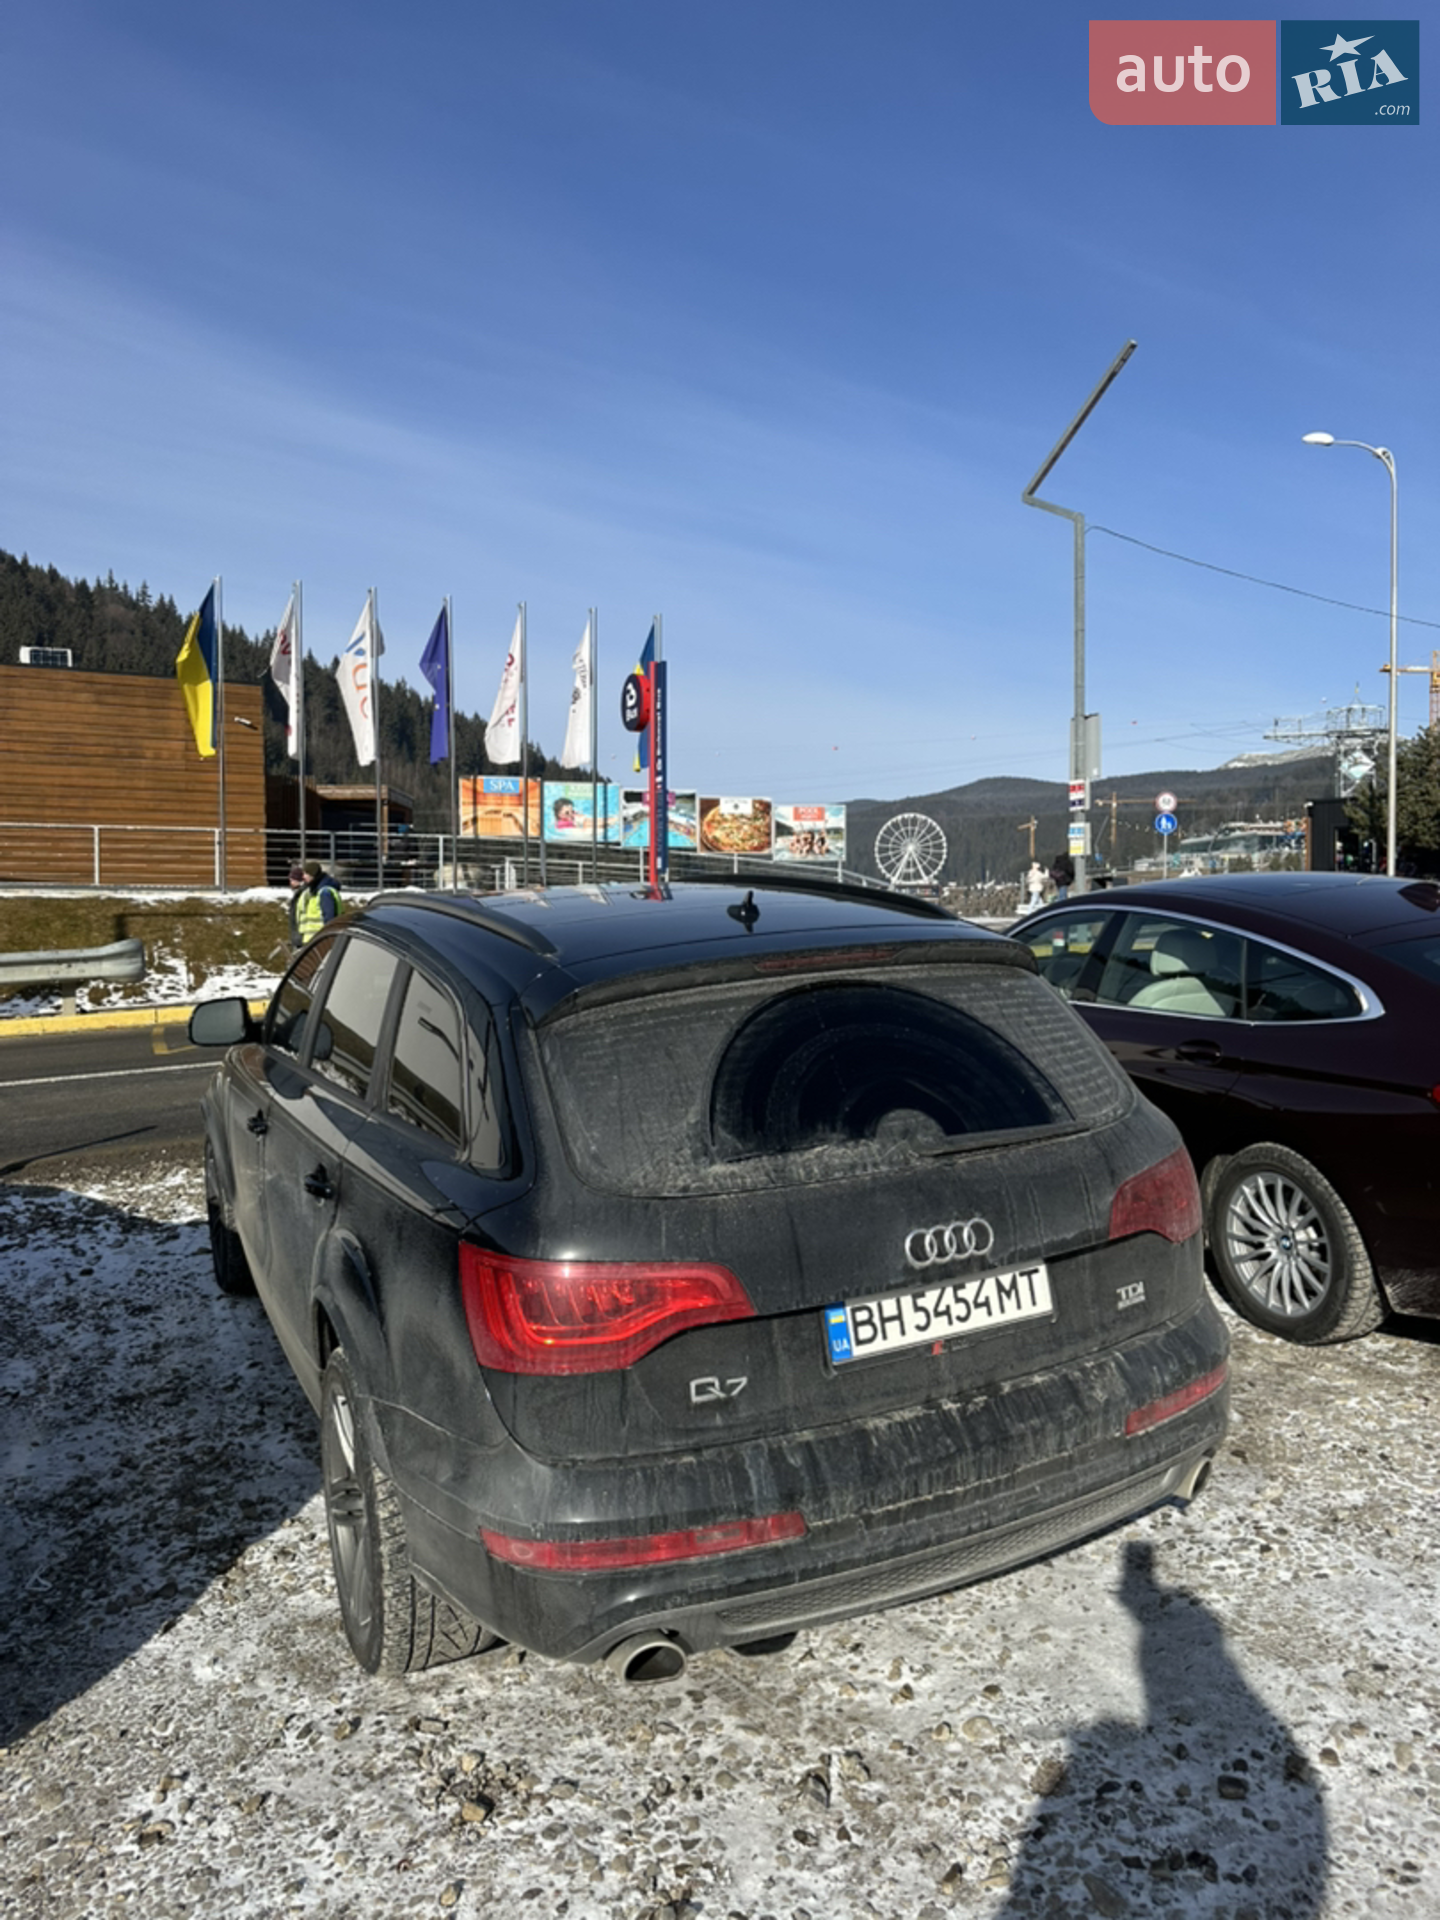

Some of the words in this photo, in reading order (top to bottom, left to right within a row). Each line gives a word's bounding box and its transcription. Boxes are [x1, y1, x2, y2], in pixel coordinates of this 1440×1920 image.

[490, 780, 514, 792] SPA
[1116, 1281, 1144, 1300] TDI
[832, 1337, 849, 1353] UA
[690, 1376, 748, 1403] Q7
